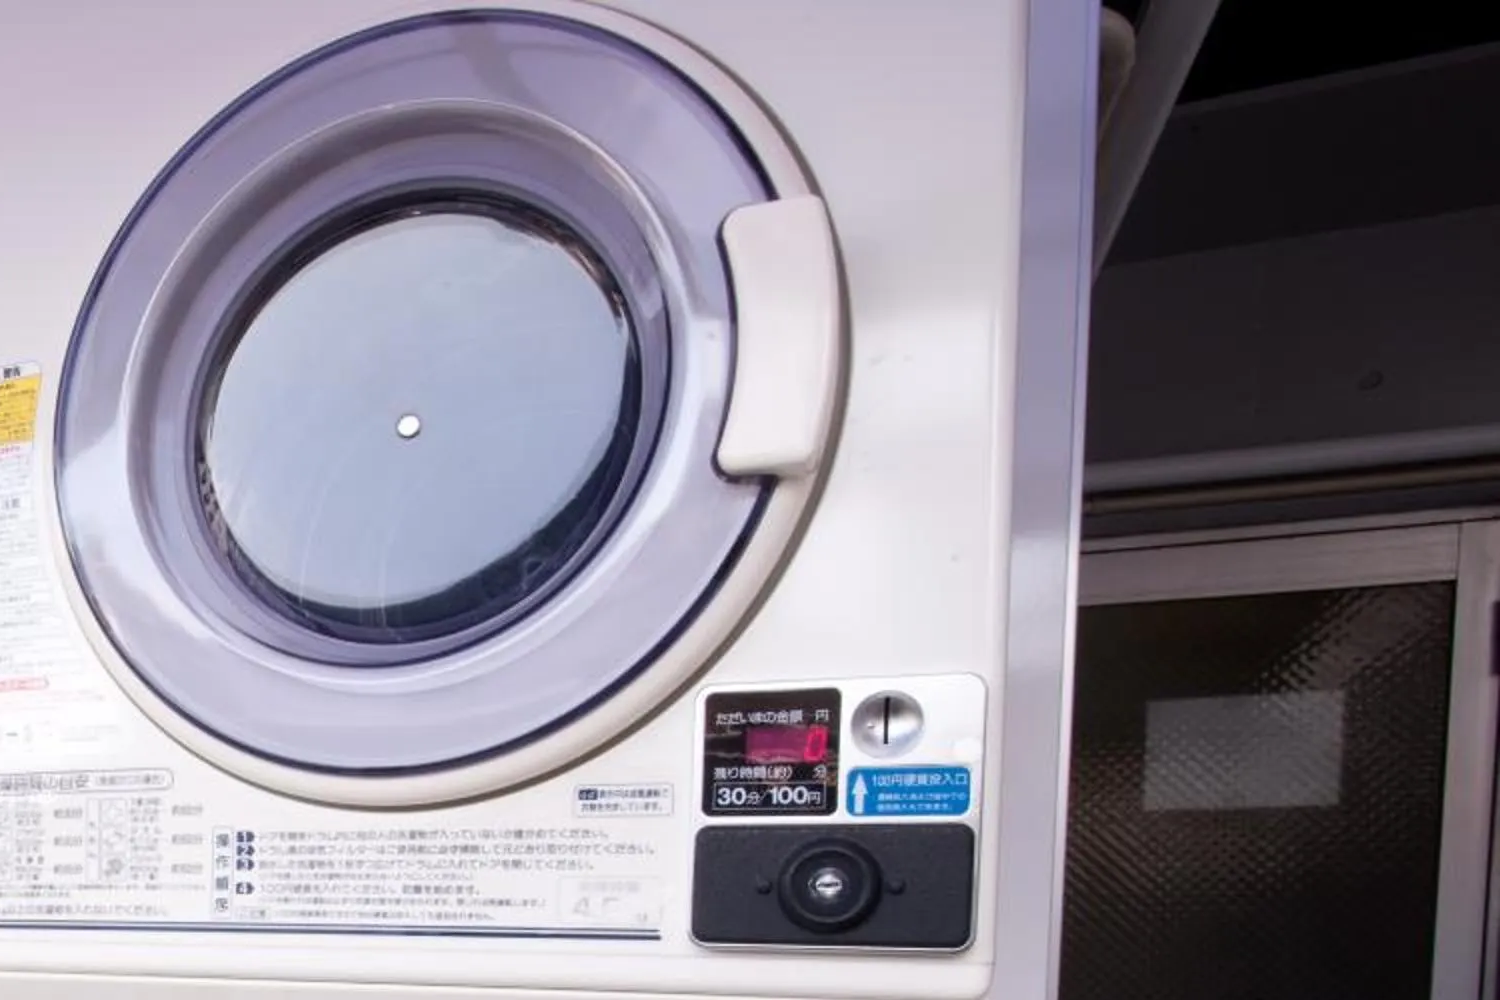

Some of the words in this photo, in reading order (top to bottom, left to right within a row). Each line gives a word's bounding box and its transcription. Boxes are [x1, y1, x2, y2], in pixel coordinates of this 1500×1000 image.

[815, 709, 830, 722] 円
[804, 725, 830, 762] 0
[812, 765, 827, 779] 分
